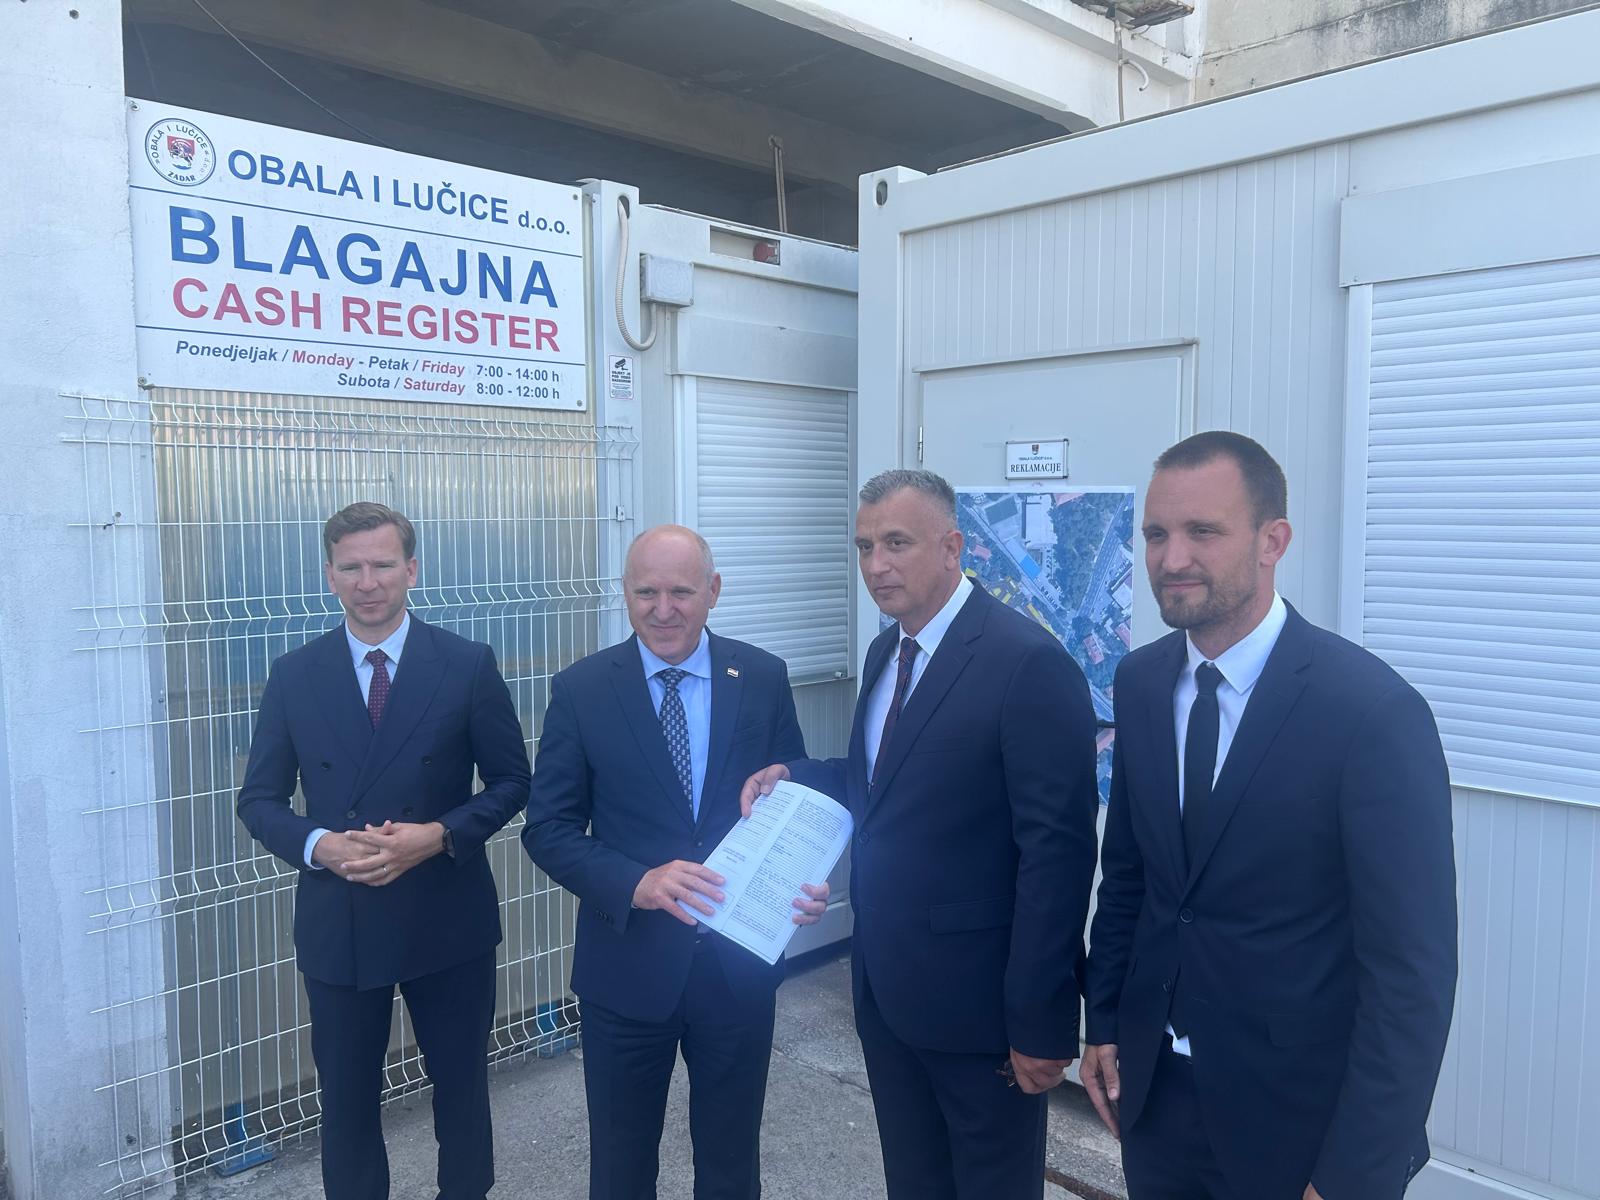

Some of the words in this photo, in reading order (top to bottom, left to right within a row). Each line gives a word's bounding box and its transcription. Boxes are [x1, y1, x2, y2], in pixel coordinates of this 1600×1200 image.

[150, 129, 165, 159] OBALA
[167, 171, 196, 182] ZADAR
[228, 149, 363, 200] OBALA
[373, 175, 380, 203] I
[393, 179, 509, 225] LUČICE
[518, 211, 571, 235] d.o.o.
[169, 205, 559, 309] BLAGAJNA
[173, 278, 322, 331] CASH
[341, 295, 561, 353] REGISTER
[176, 340, 278, 363] Ponedjeljak
[292, 350, 355, 369] Monday
[368, 355, 409, 371] Petak
[421, 360, 465, 377] Friday
[476, 365, 503, 378] 7:00
[515, 368, 548, 381] 14:00
[552, 370, 560, 382] h
[337, 373, 390, 388] Subota
[403, 377, 466, 396] Saturday
[476, 383, 504, 396] 8:00
[516, 386, 549, 399] 12:00
[552, 387, 560, 399] h
[1010, 463, 1061, 473] REKLAMACIJE
